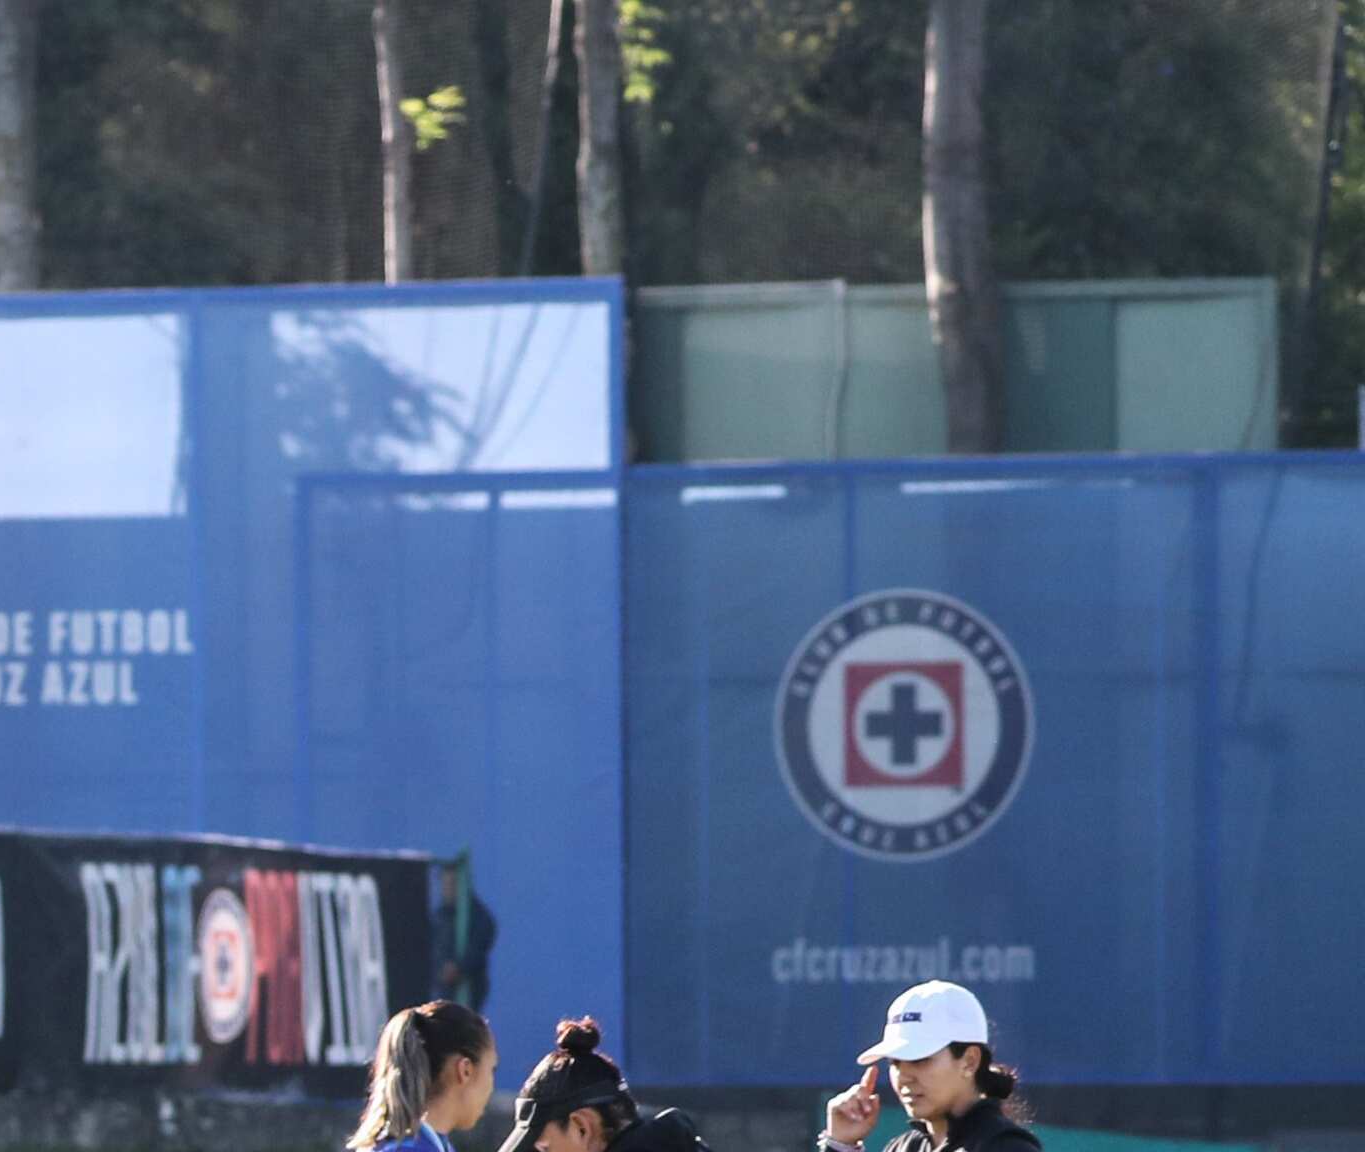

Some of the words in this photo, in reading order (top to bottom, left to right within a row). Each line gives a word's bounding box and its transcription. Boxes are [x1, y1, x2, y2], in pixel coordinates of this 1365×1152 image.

[48, 608, 195, 656] FUTBOL
[40, 659, 139, 706] AZUL
[772, 936, 1036, 984] cfcruzazul.com
